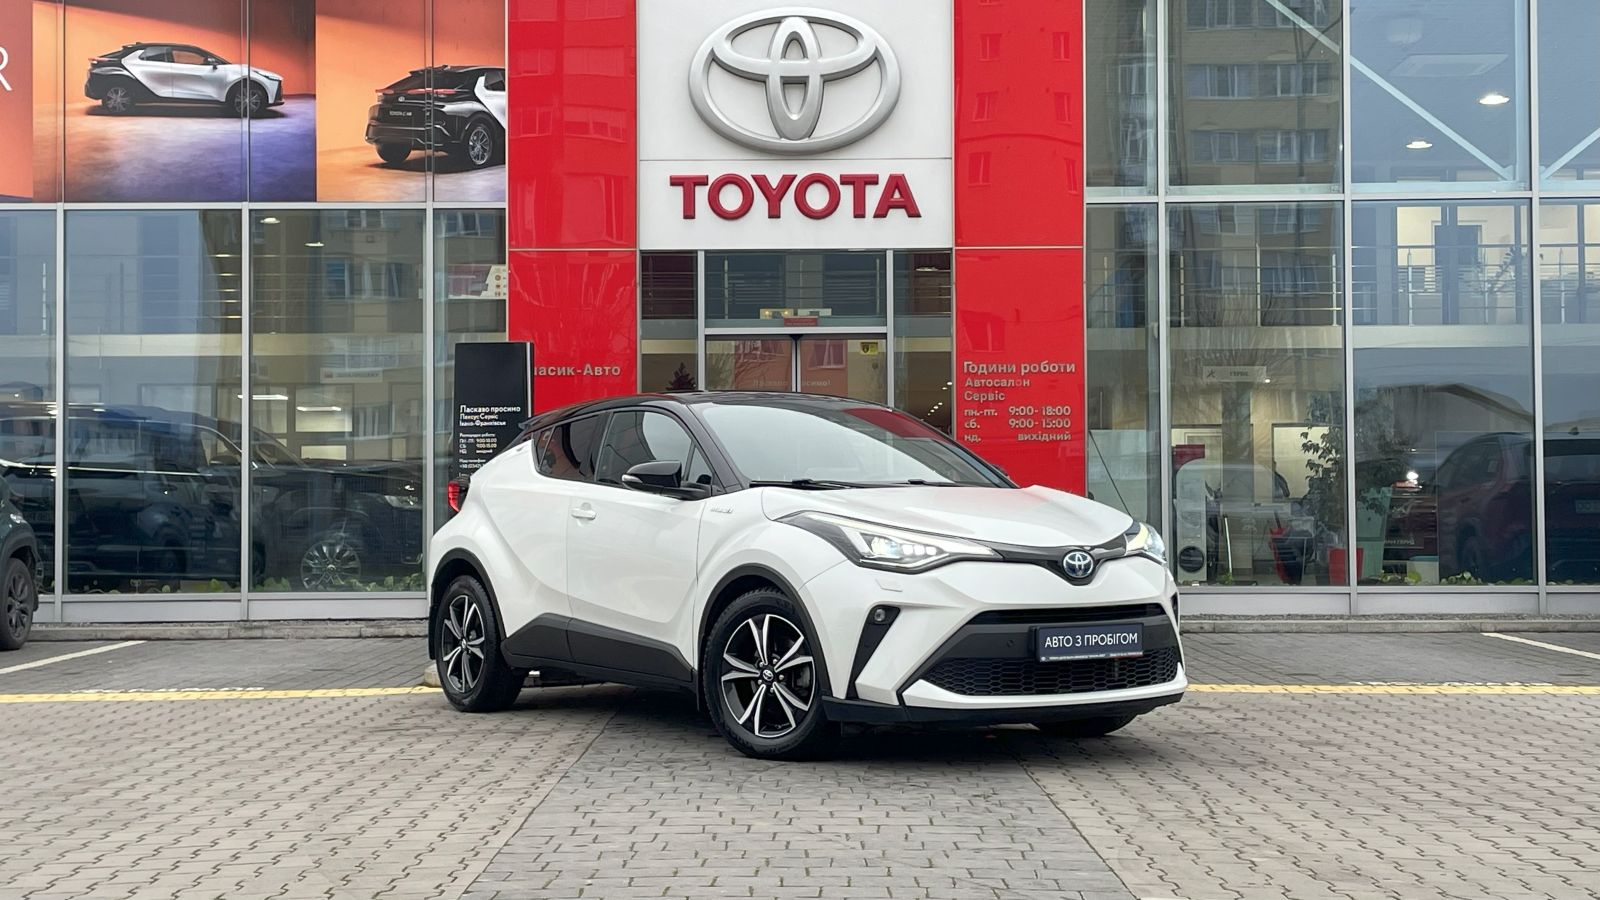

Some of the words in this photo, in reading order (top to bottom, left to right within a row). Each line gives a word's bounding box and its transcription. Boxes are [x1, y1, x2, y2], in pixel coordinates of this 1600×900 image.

[669, 173, 922, 221] TOYOTA
[963, 361, 1016, 375] Години
[1021, 360, 1076, 376] роботи
[965, 378, 1030, 387] Автосалон
[964, 391, 1006, 403] Сервіс
[460, 405, 490, 413] Ласкаво
[491, 406, 521, 414] просимо
[964, 418, 980, 429] сб.
[964, 433, 982, 442] нд.
[1017, 431, 1071, 442] вихідний
[1044, 635, 1073, 649] АВТО
[1084, 632, 1138, 647] ПРОБІГОМ
